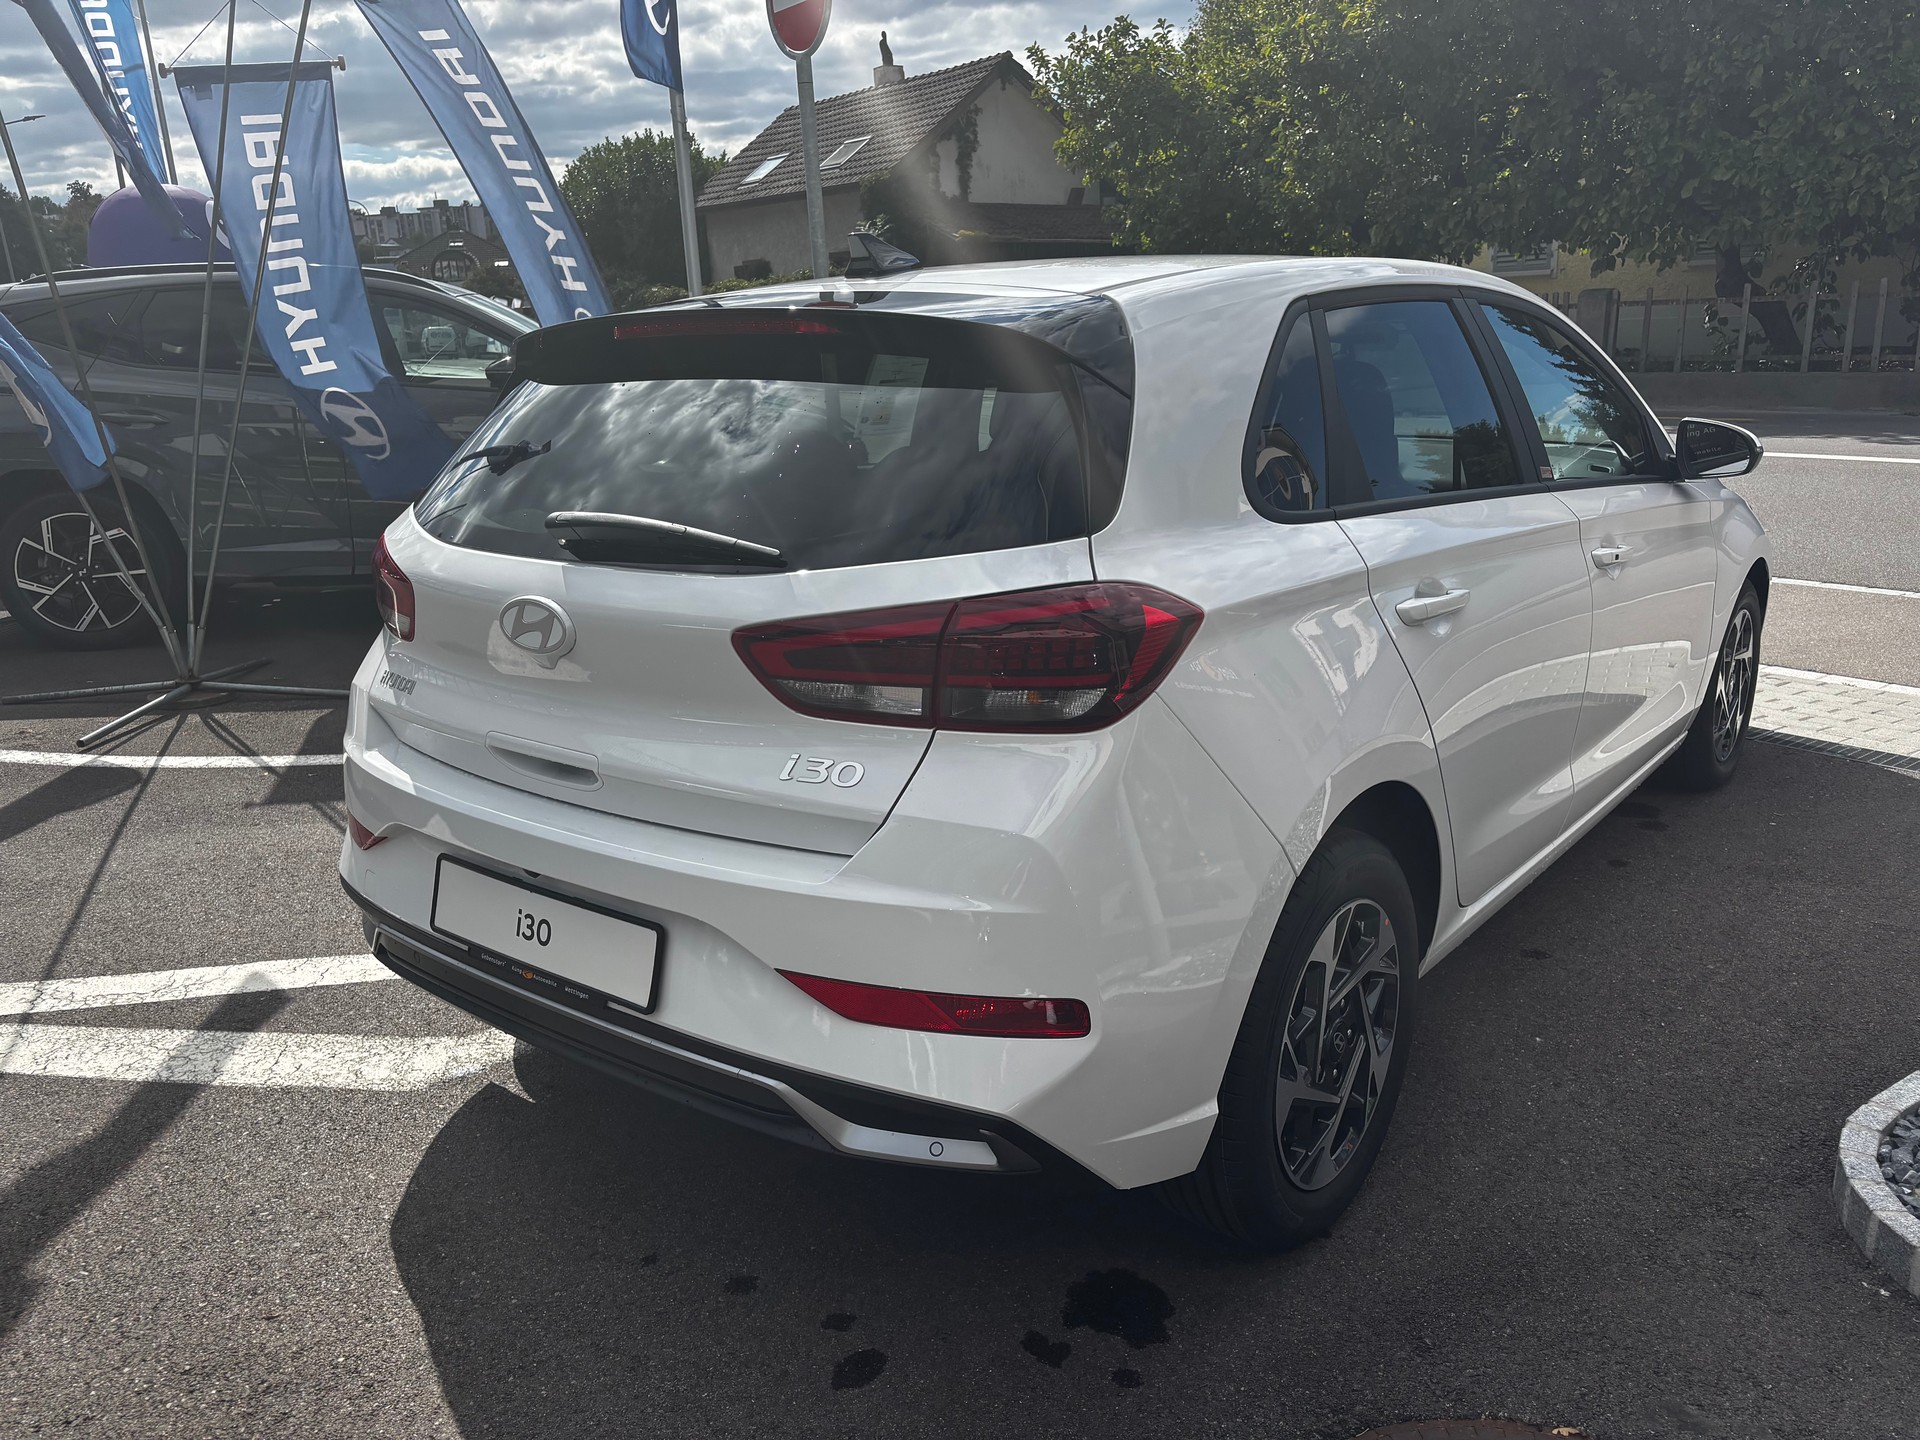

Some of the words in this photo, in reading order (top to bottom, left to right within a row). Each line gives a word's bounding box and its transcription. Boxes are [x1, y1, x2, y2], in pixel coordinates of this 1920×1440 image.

[418, 28, 588, 291] HYUNDAI
[240, 113, 338, 376] HYUNDAI
[380, 669, 417, 696] HYUNDAI
[779, 752, 865, 788] i30
[515, 908, 552, 947] i30
